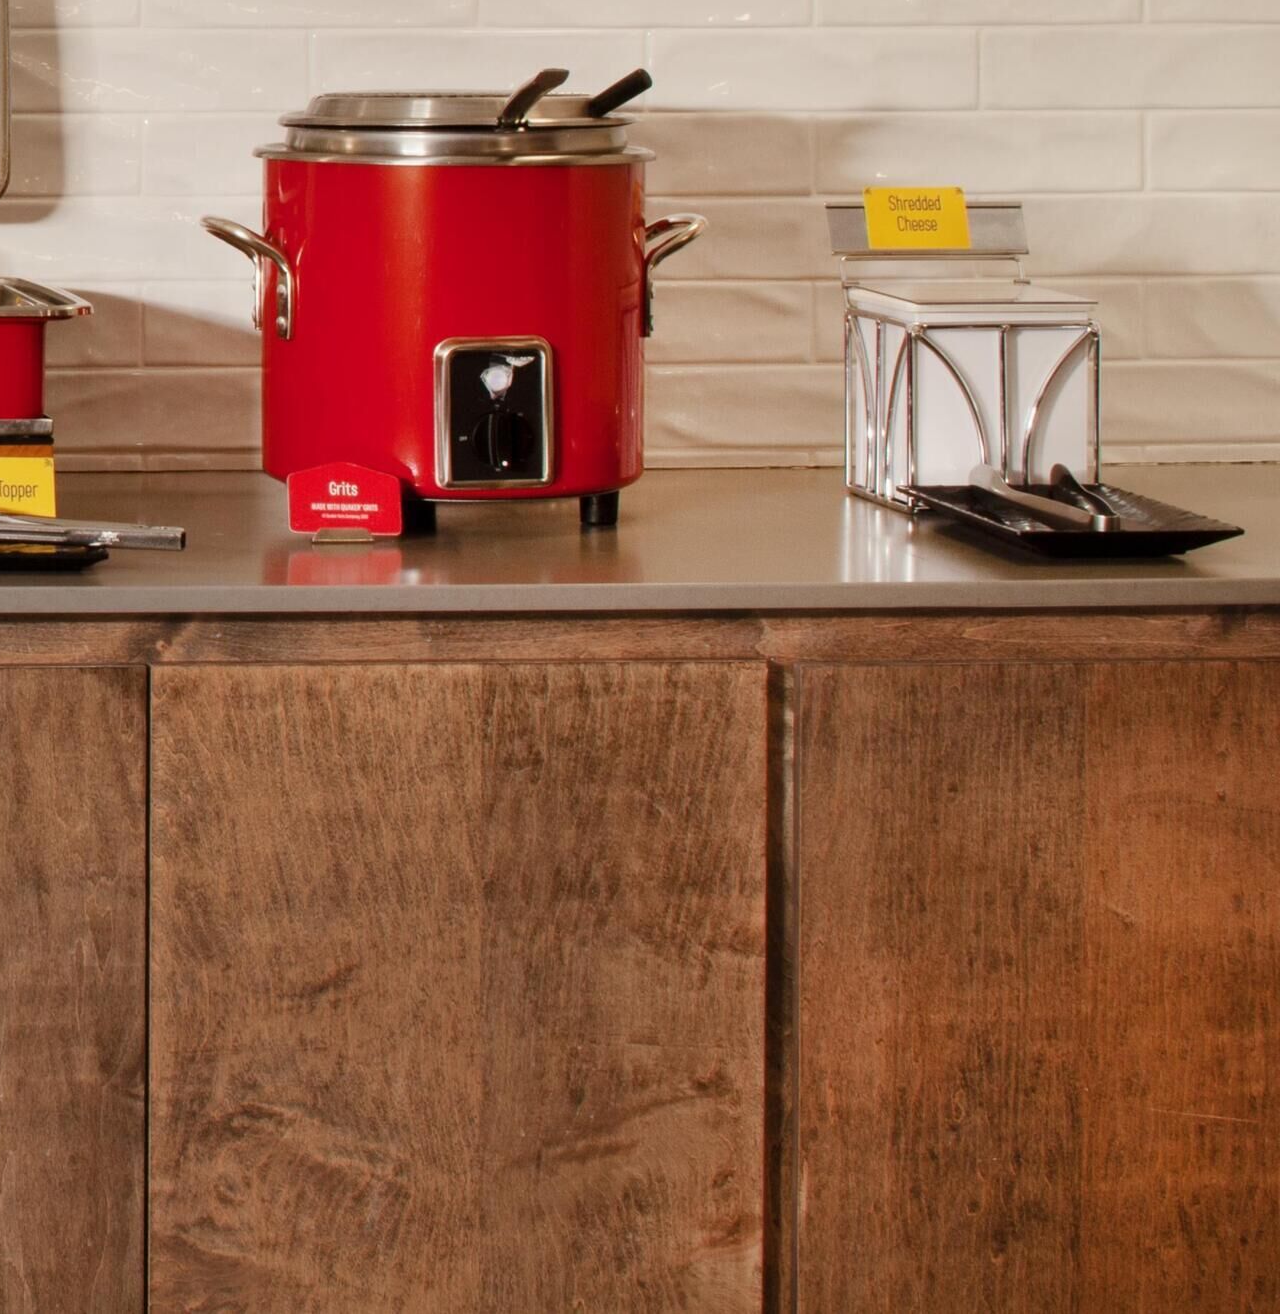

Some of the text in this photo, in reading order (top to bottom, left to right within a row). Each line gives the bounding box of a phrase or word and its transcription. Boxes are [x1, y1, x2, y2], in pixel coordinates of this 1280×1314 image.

[888, 194, 942, 212] Shredded
[896, 215, 938, 232] Cheese
[328, 480, 359, 497] Grits
